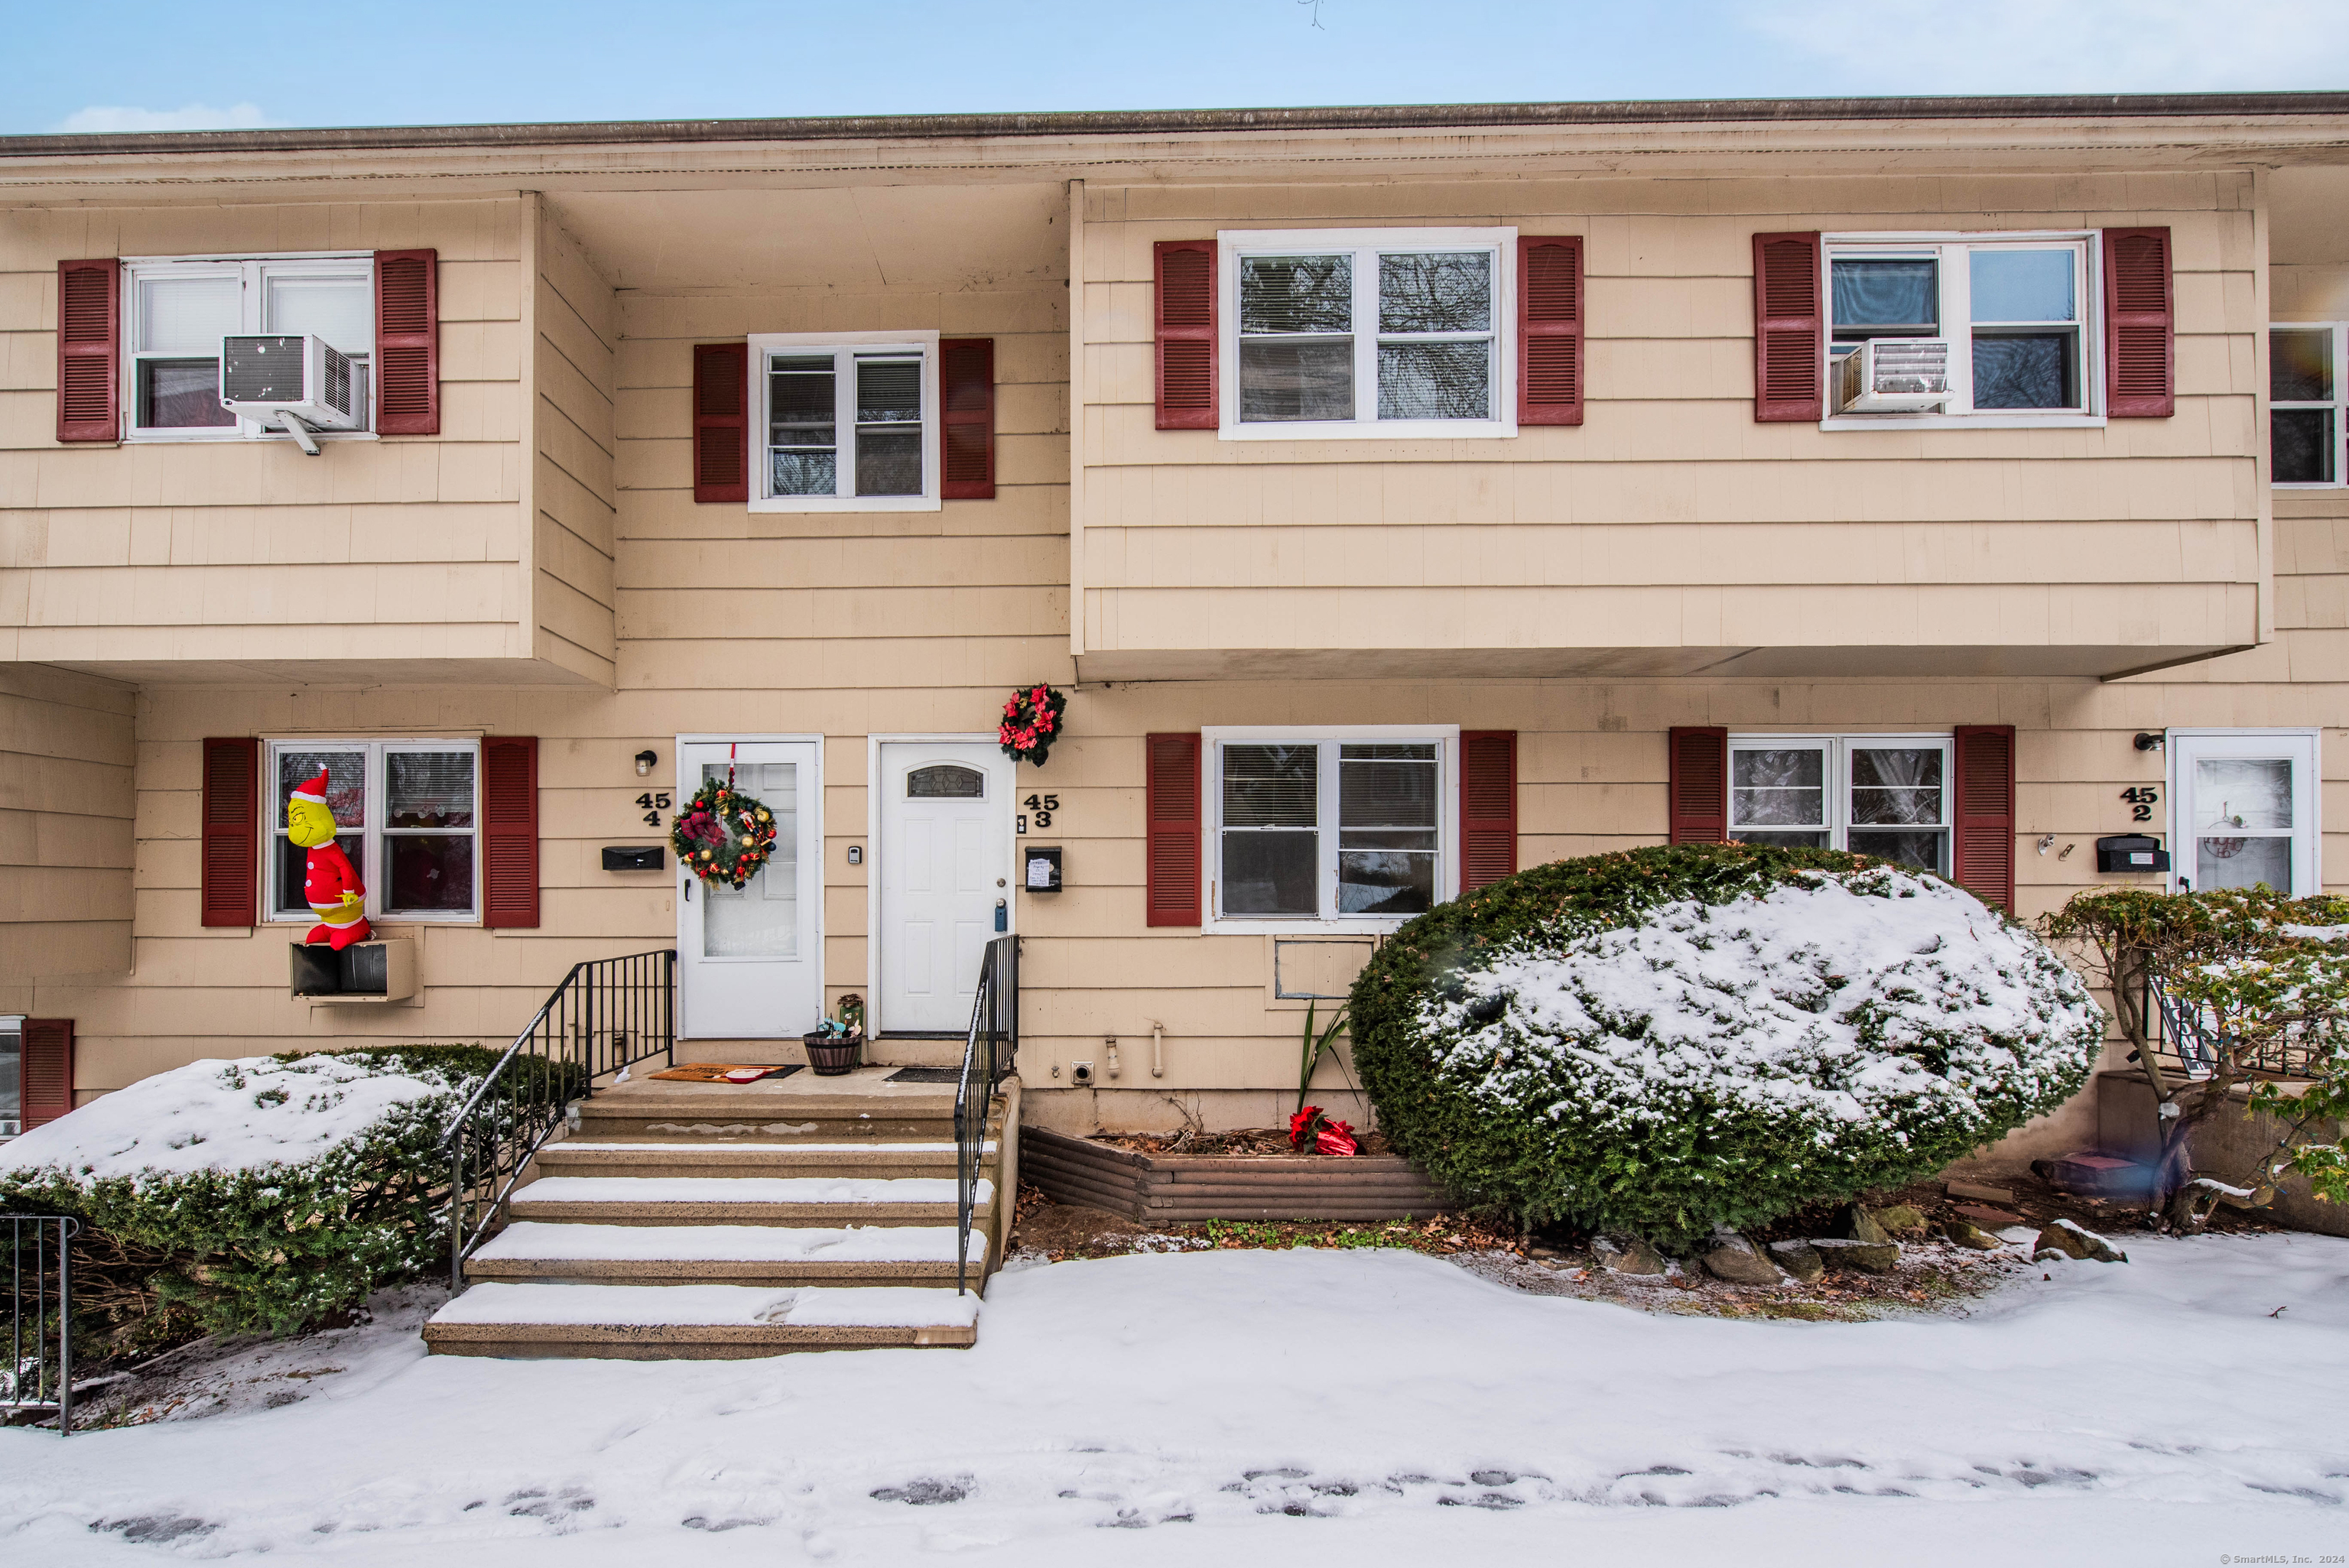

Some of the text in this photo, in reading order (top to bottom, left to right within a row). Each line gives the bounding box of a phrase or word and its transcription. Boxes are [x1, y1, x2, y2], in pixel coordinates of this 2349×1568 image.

[635, 792, 671, 809] 45
[1023, 794, 1060, 811] 45
[2120, 787, 2158, 803] 45
[642, 810, 661, 826] 4
[1035, 811, 1051, 828] 3
[2132, 804, 2152, 822] 2
